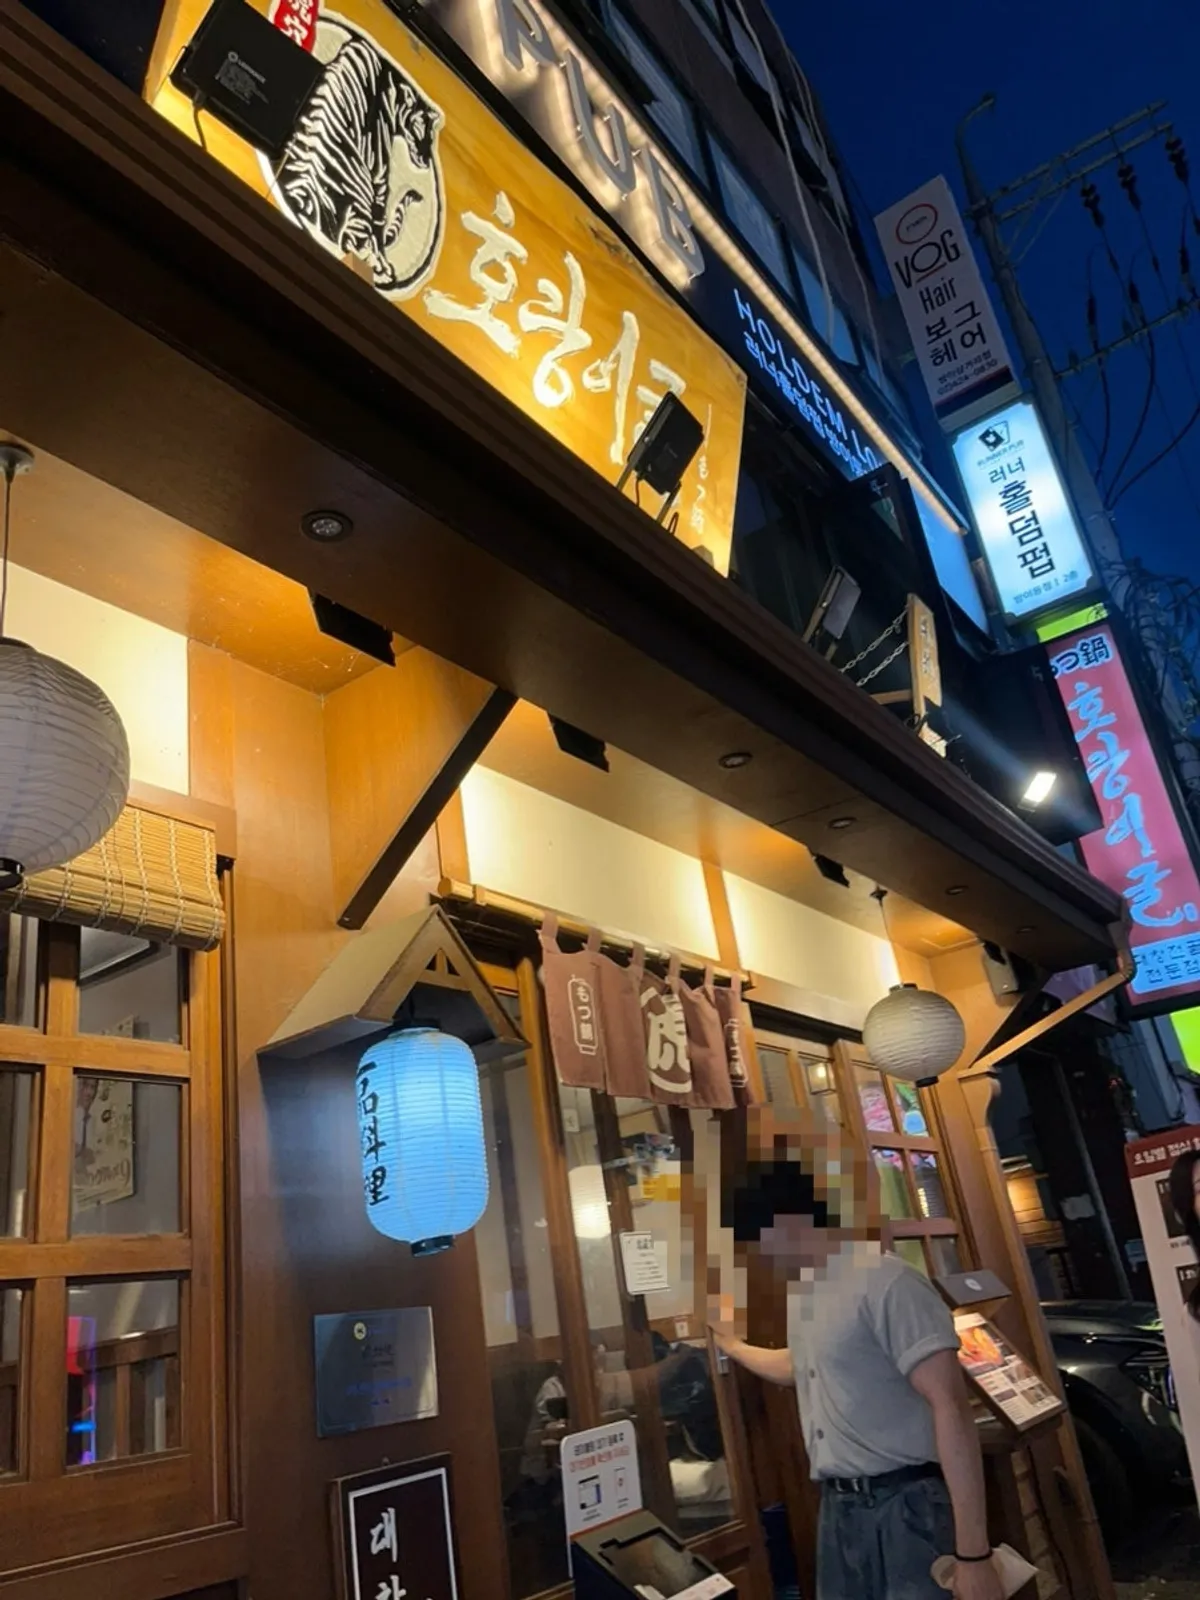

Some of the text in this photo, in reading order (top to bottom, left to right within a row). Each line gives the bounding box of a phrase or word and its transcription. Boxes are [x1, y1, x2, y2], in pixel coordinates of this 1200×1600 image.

[497, 0, 705, 276] PUB
[894, 228, 961, 290] VOG
[919, 277, 957, 315] Hair
[926, 300, 982, 345] 보그
[929, 322, 987, 367] 헤어
[733, 287, 882, 471] HOLDEM LO
[988, 456, 1026, 484] 러너
[998, 480, 1056, 580] 홀덤펍
